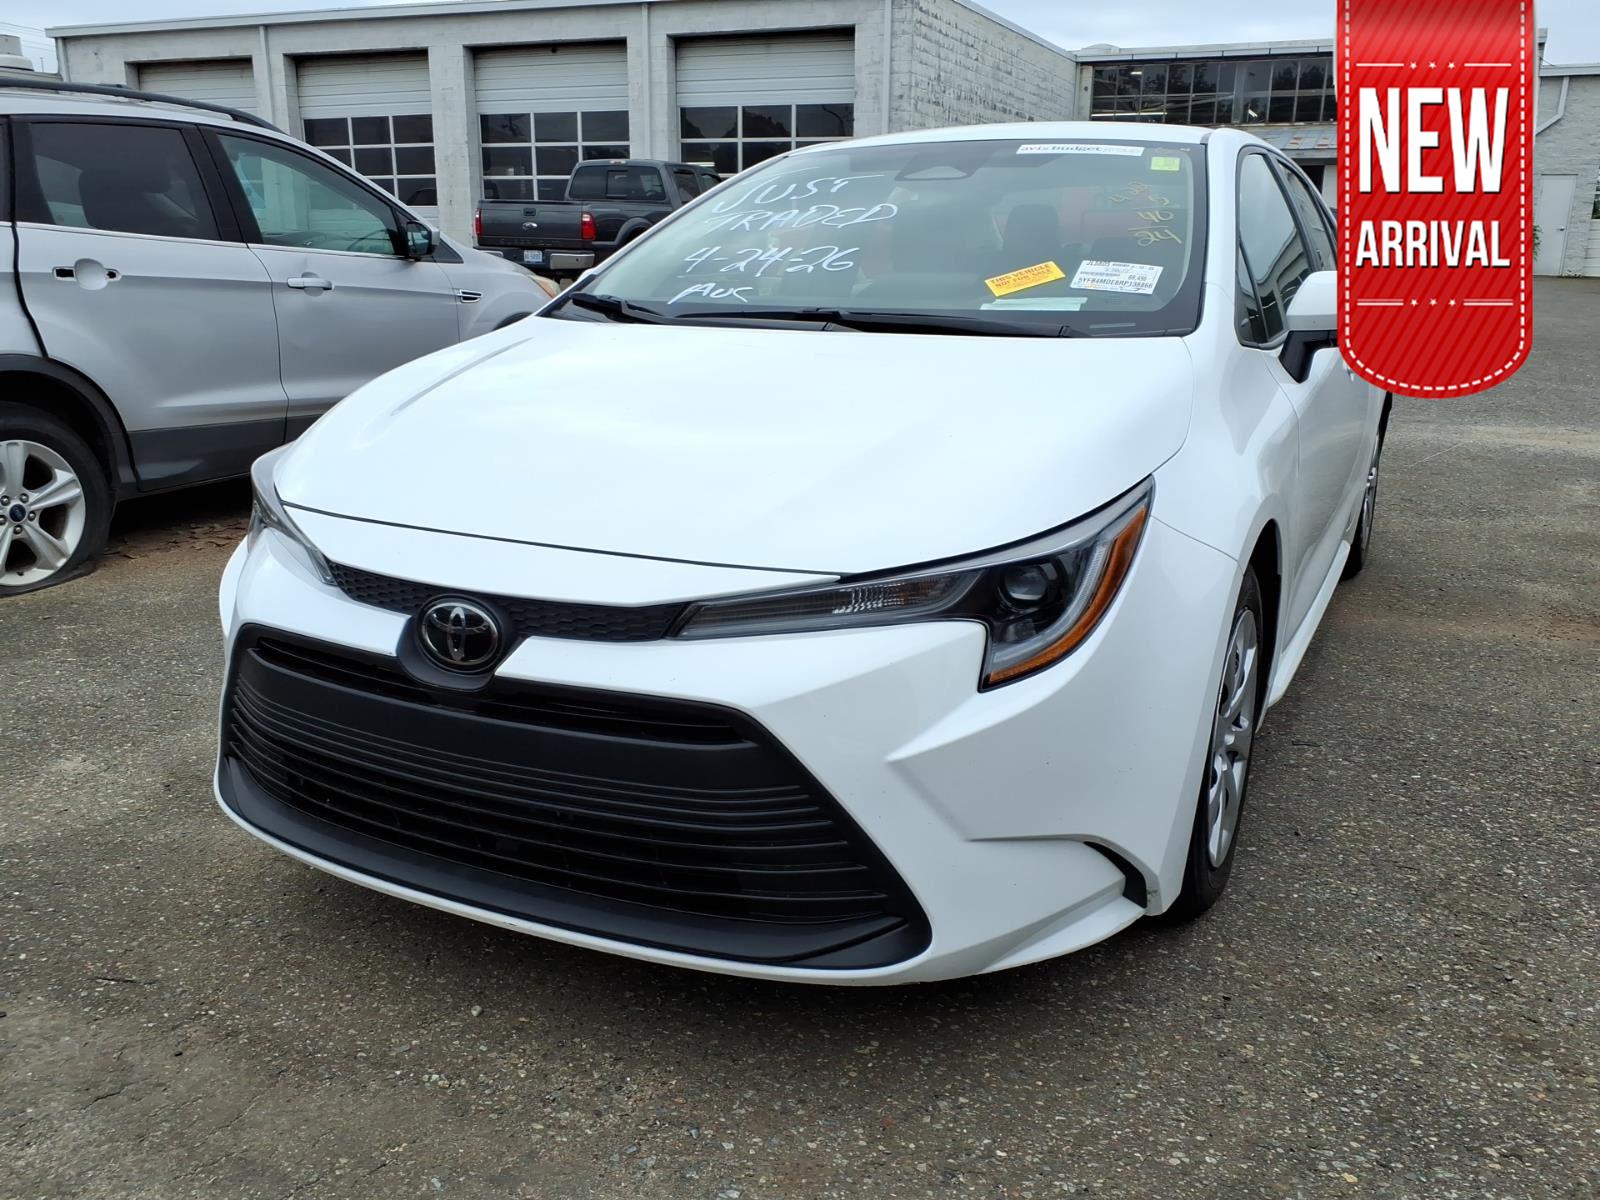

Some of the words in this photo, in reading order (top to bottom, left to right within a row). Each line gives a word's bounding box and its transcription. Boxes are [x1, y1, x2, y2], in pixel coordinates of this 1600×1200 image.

[712, 167, 885, 214] JUST
[704, 203, 898, 233] TRADED
[684, 245, 860, 277] 4-24-26
[1012, 263, 1051, 278] VEHICLE
